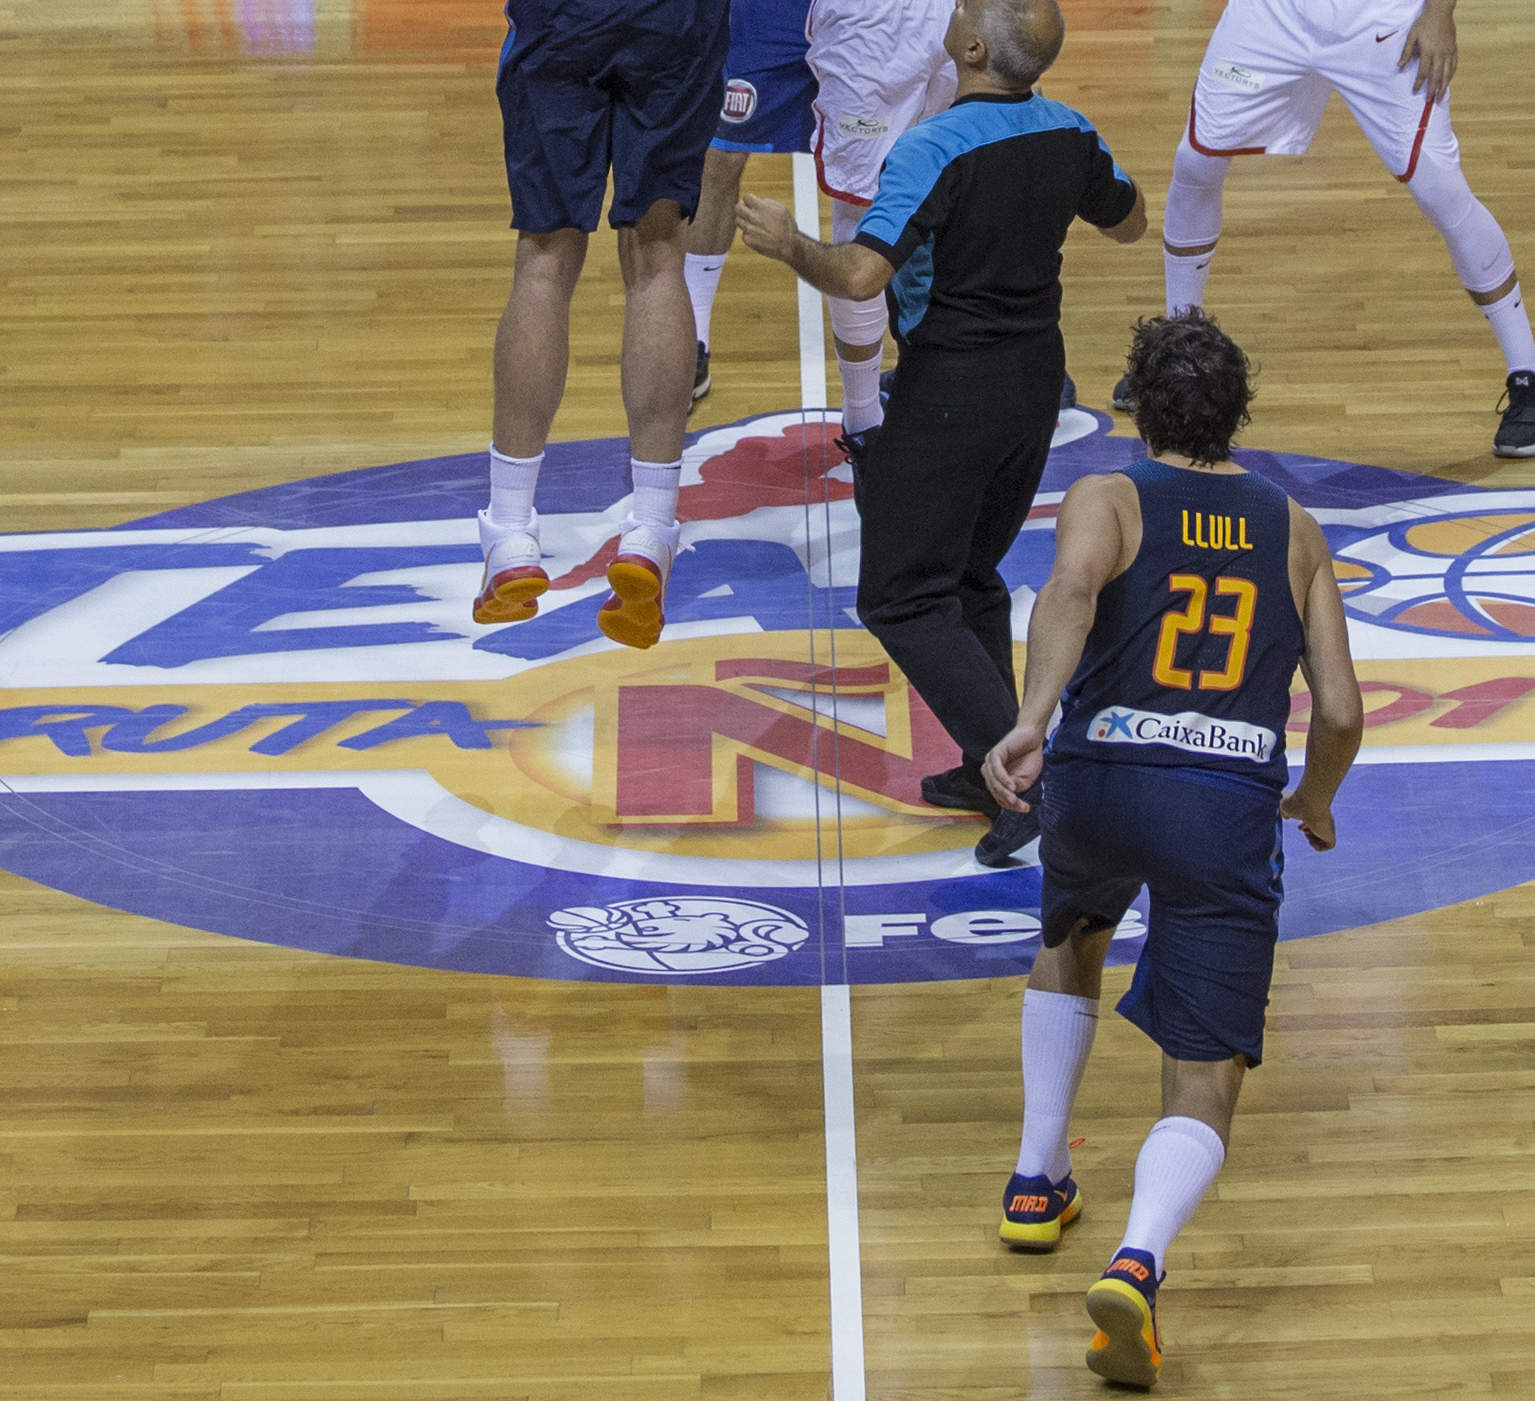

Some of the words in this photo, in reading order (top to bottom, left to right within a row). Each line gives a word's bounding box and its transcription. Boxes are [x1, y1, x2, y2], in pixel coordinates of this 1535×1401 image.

[724, 91, 752, 113] FIAT
[1182, 510, 1254, 550] LLULL
[1152, 573, 1259, 691] 23
[1135, 716, 1268, 760] CaixaBank
